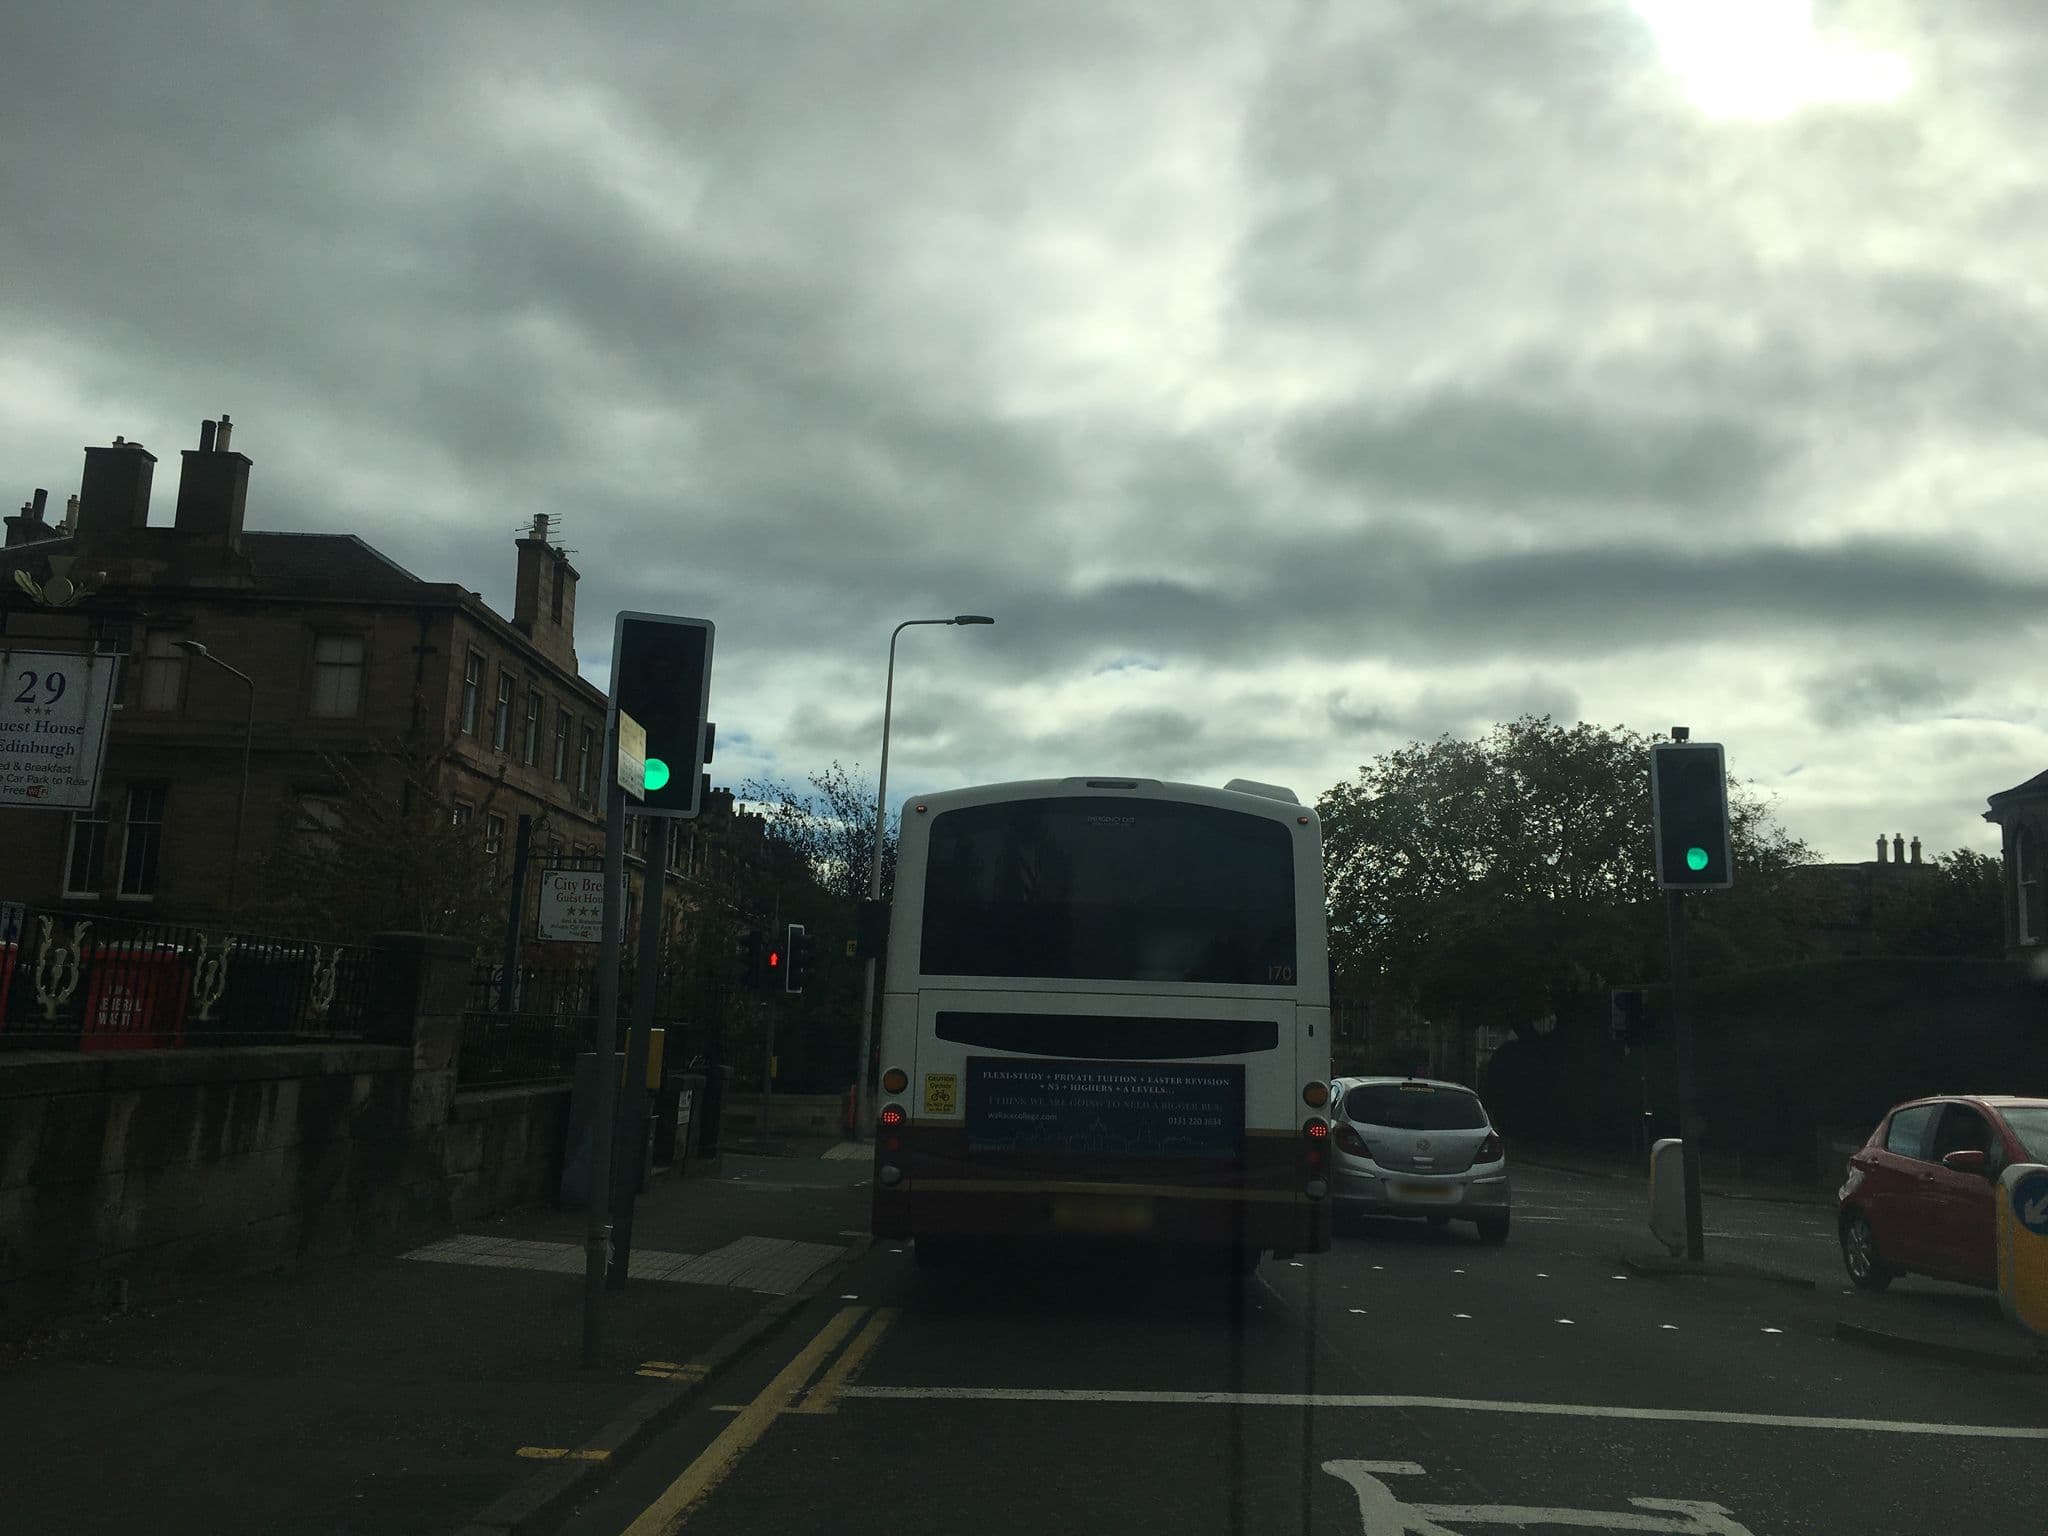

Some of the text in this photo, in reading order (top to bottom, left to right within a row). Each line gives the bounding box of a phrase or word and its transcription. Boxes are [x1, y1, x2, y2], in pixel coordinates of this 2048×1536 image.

[14, 670, 66, 705] 29
[0, 720, 85, 735] uest House
[0, 762, 72, 774] ed & Breakfast
[6, 773, 24, 784] Car
[27, 774, 49, 785] Park
[52, 776, 63, 785] to
[66, 777, 90, 786] Rear
[3, 785, 26, 795] Free
[554, 877, 577, 892] City
[556, 892, 604, 904] Guest Hou
[1268, 965, 1292, 981] 170
[983, 1071, 1230, 1087] FLEXI-STUDY PRIVATE TUITION EASTER REVISION
[1070, 1083, 1113, 1092] HIGHERS
